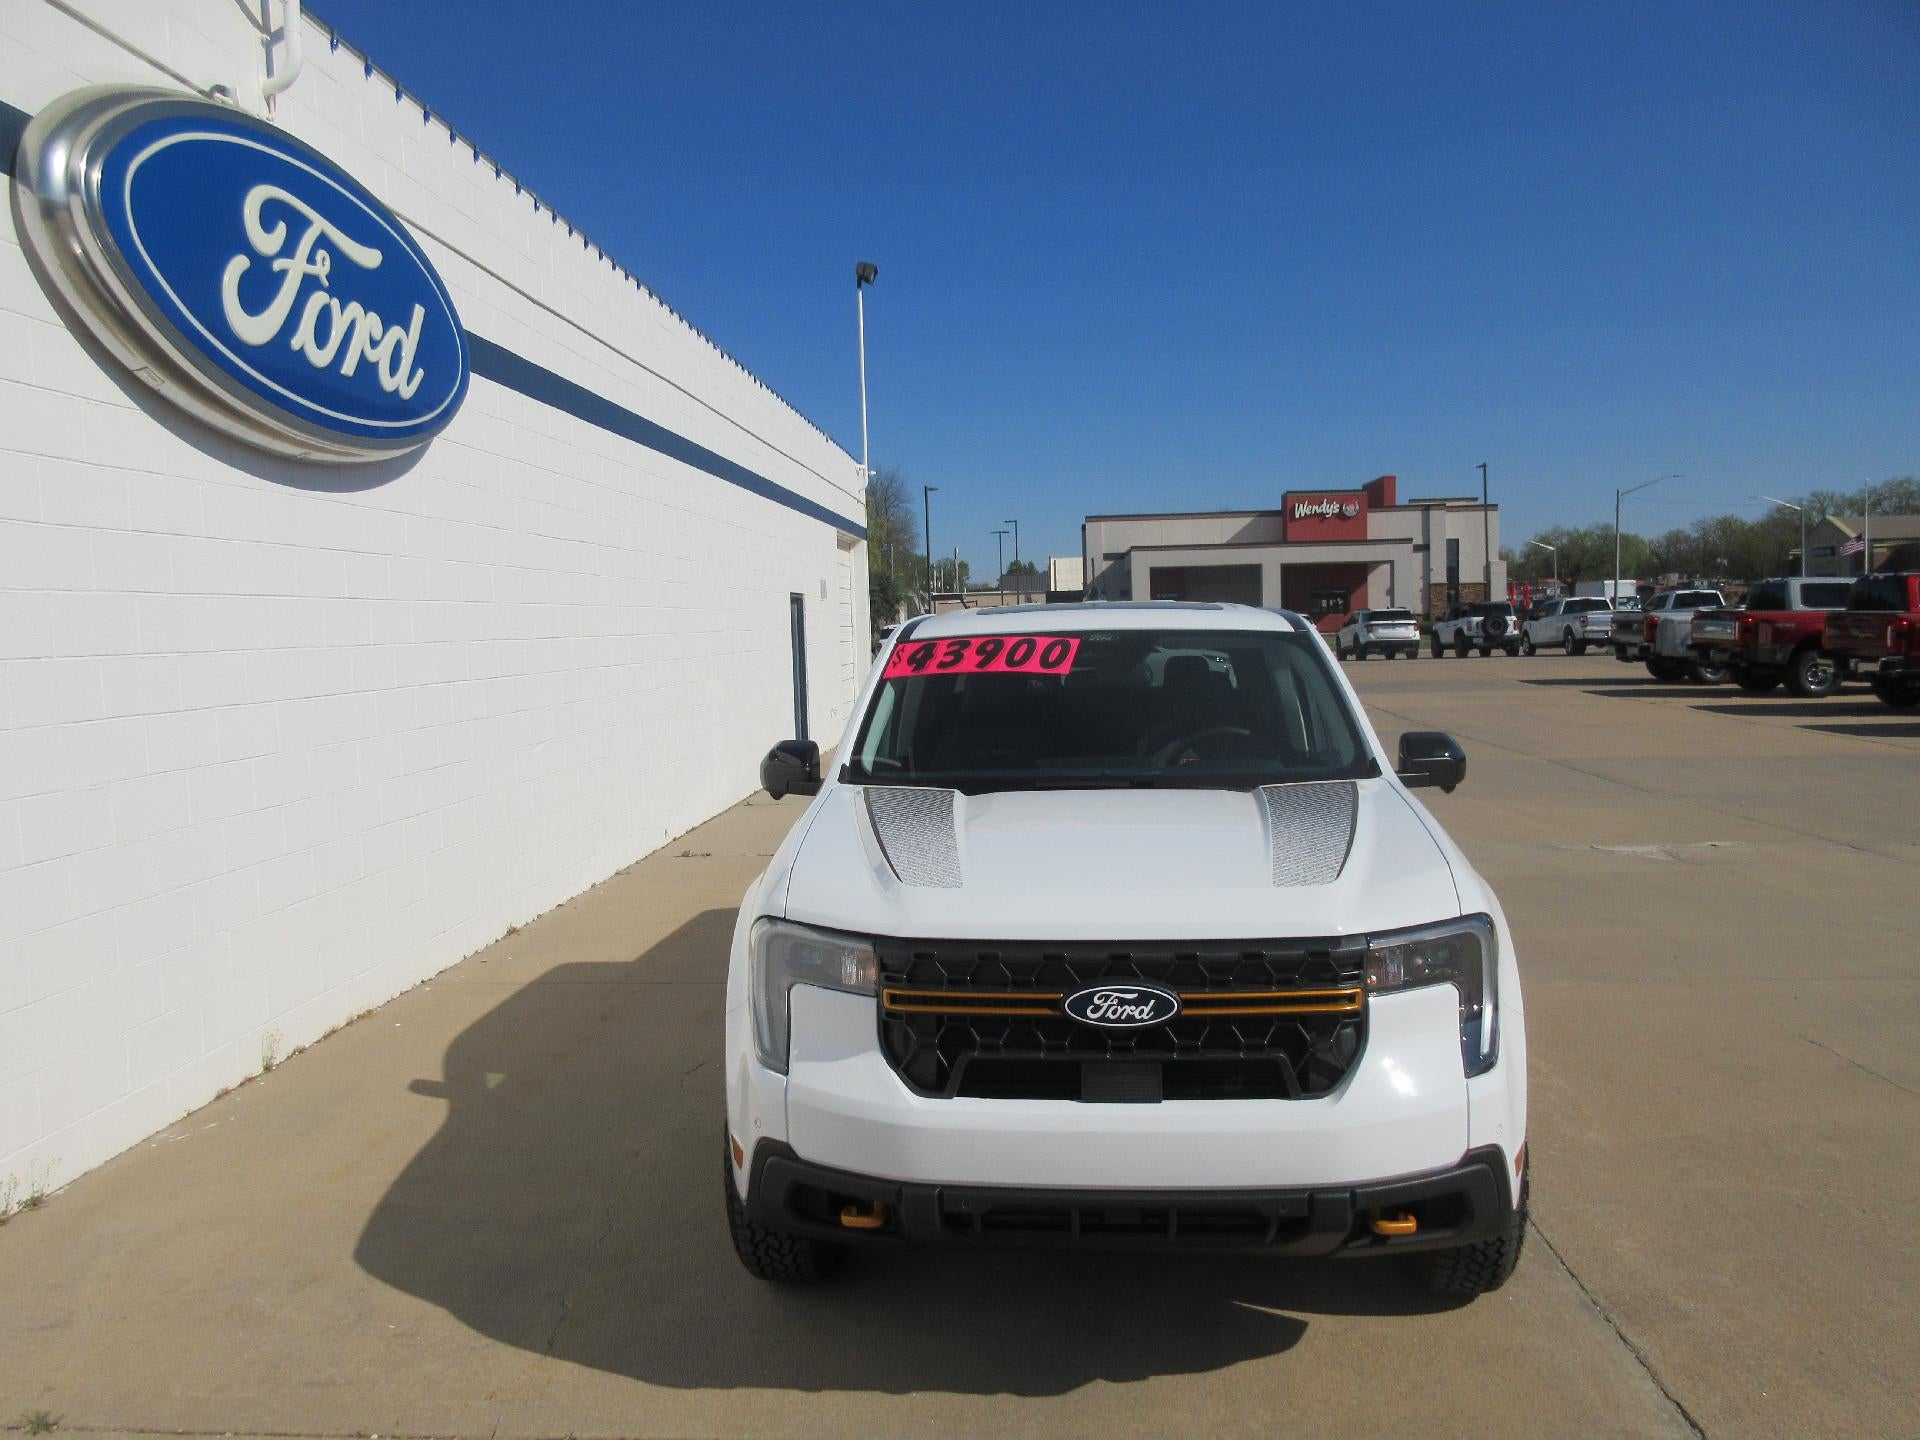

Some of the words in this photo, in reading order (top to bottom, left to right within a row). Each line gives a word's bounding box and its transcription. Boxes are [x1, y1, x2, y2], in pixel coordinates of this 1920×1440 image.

[222, 184, 426, 400] Ford
[1294, 498, 1340, 518] Wendy's
[1086, 991, 1156, 1020] Ford
